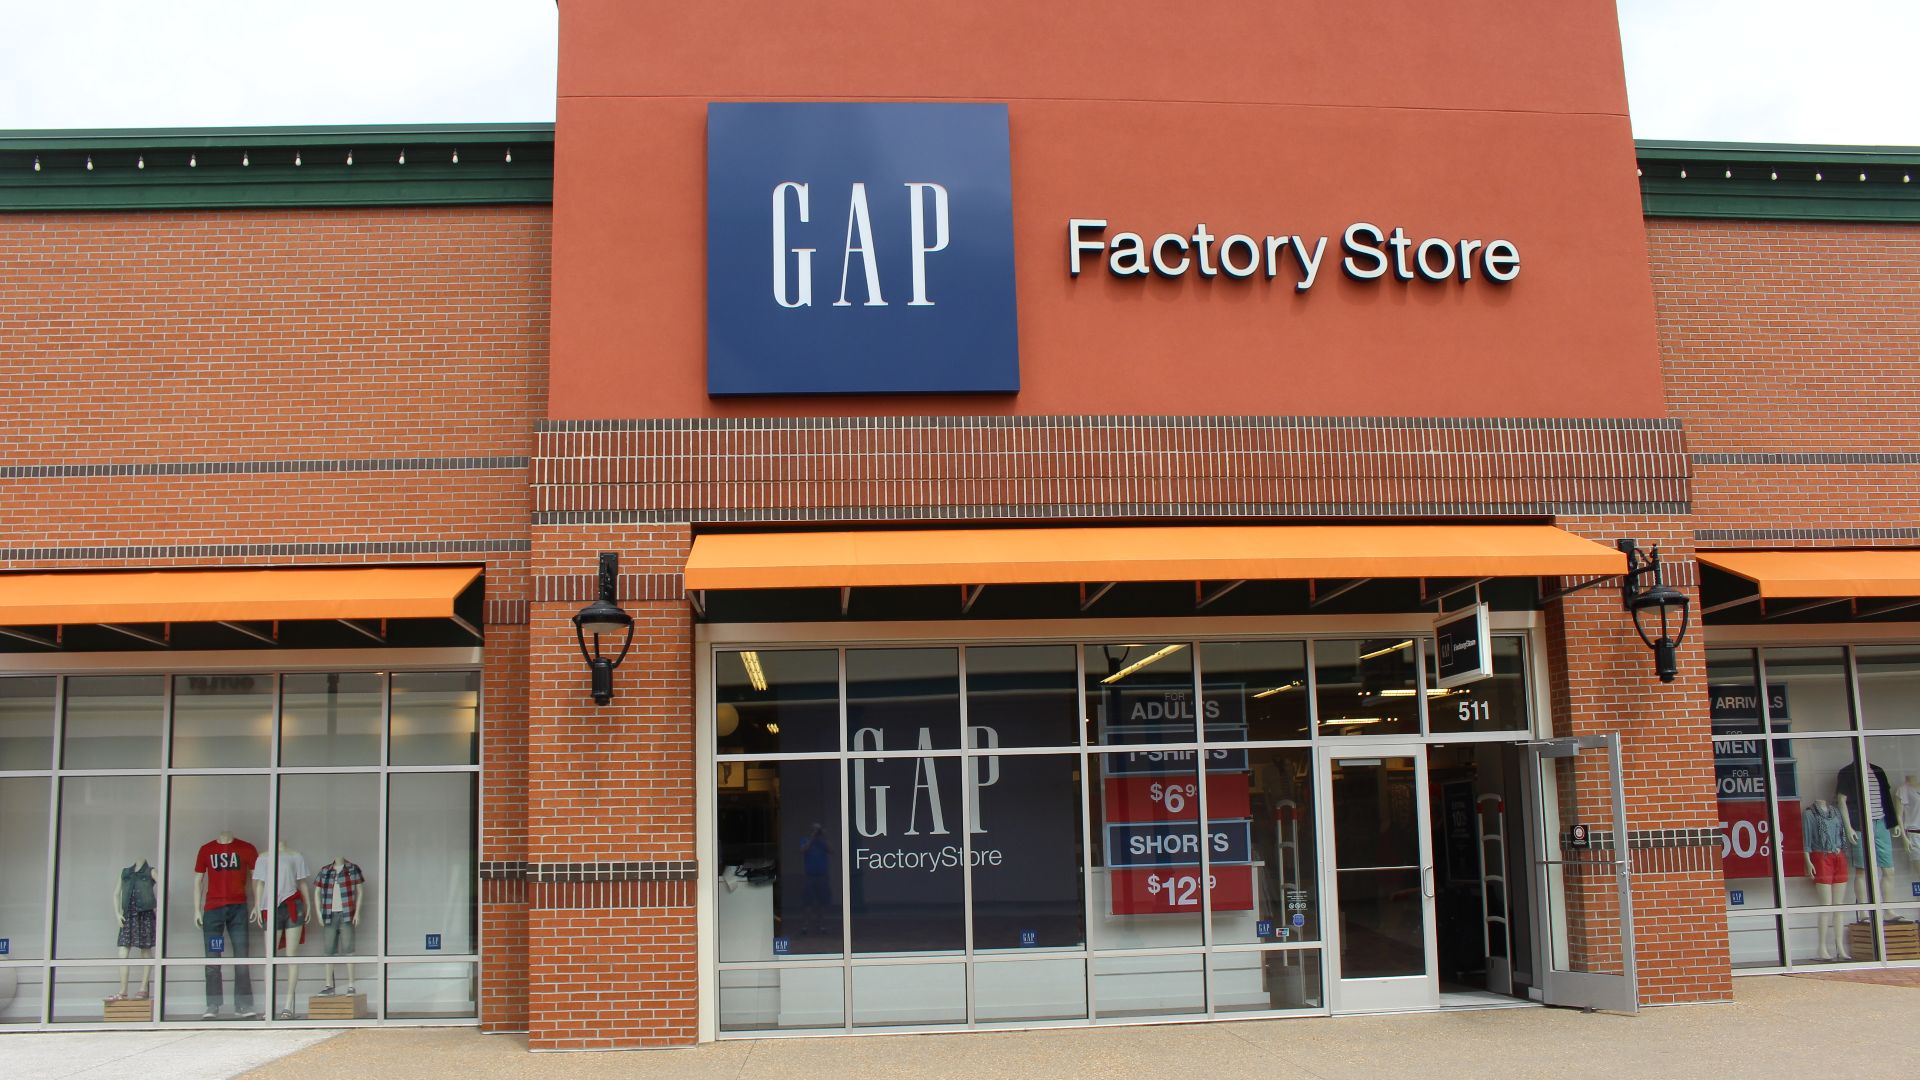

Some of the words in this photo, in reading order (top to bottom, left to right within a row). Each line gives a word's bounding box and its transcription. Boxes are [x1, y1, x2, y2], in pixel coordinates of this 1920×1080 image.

[772, 181, 950, 308] GAP
[1069, 218, 1328, 290] Factory
[1343, 222, 1522, 281] Store
[1165, 691, 1185, 701] FOR
[1715, 696, 1784, 709] ARRIVS
[1130, 701, 1220, 720] ADULS
[1458, 701, 1490, 721] 511
[1715, 740, 1757, 754] MEN
[853, 726, 1000, 838] GAP
[1732, 769, 1749, 778] FOR
[1716, 777, 1765, 793] OME
[1150, 782, 1197, 813] $69
[1130, 833, 1229, 855] SHORS
[210, 852, 239, 870] USA
[856, 846, 1002, 873] FactoryStore
[1147, 874, 1217, 906] $129
[1258, 923, 1270, 932] GAP
[775, 940, 788, 950] GAP
[1022, 932, 1035, 942] GAP
